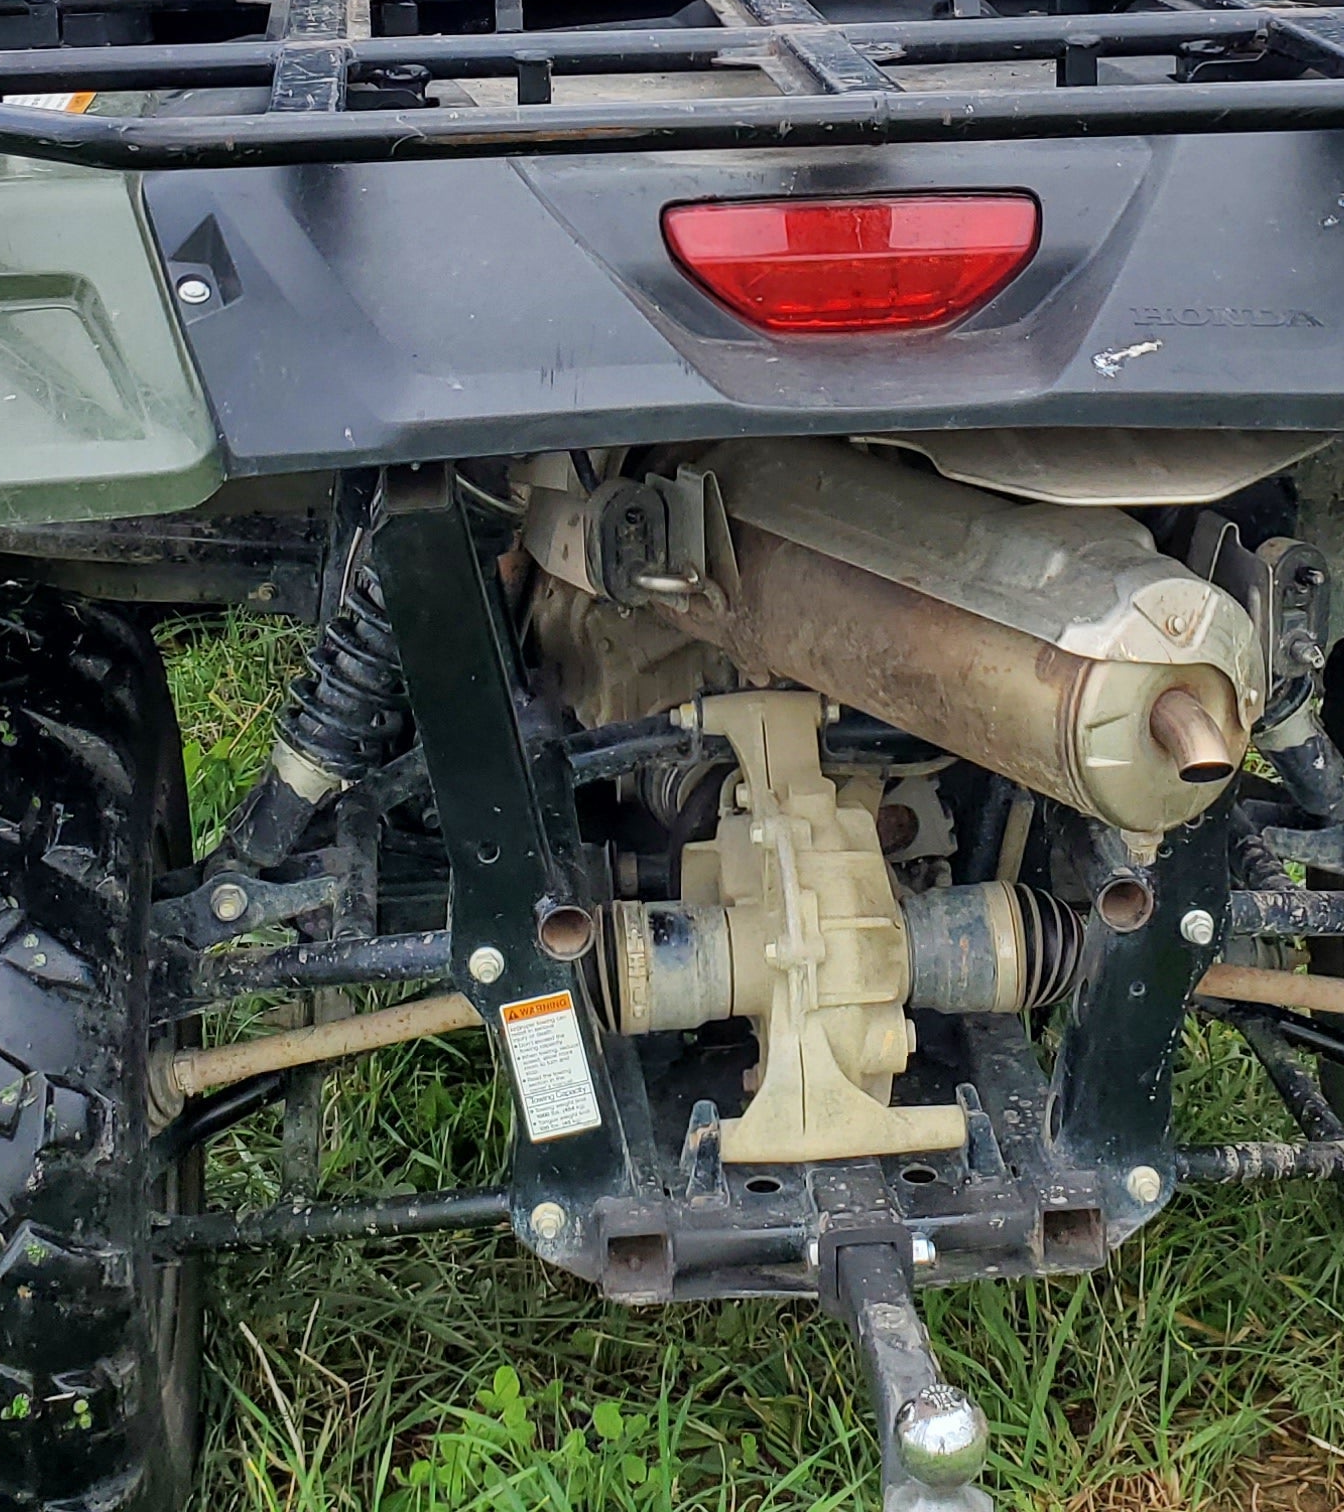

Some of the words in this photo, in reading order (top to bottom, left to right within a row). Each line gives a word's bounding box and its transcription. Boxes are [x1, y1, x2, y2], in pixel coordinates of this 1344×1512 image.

[1129, 307, 1325, 328] HONDA
[518, 998, 567, 1016] WARNING
[530, 1093, 555, 1104] Towing
[554, 1084, 586, 1098] Capacity
